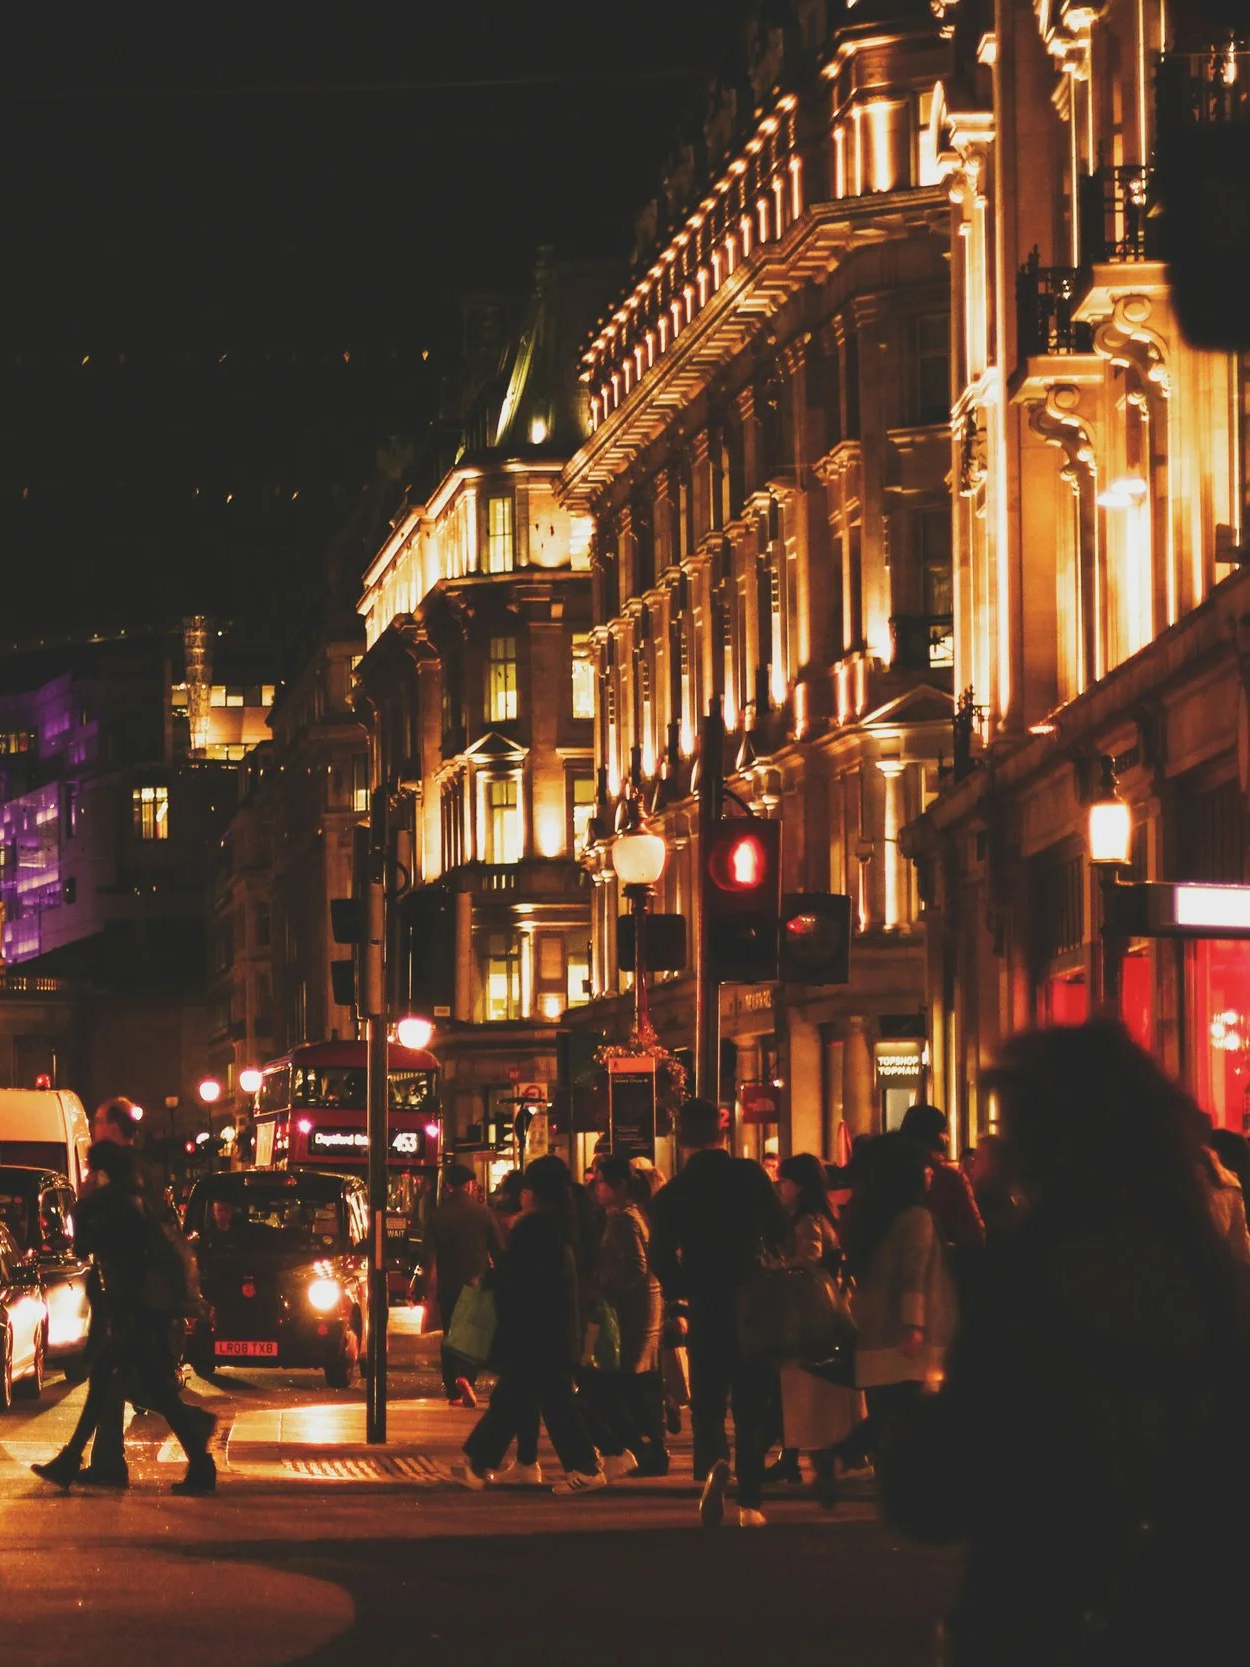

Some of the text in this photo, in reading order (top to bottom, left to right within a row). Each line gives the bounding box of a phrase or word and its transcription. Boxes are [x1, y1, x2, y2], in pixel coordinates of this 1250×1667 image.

[878, 1056, 919, 1066] TOPSHOP
[878, 1066, 919, 1076] TOPMAN
[392, 1132, 418, 1153] 453
[387, 1230, 404, 1238] WAIT
